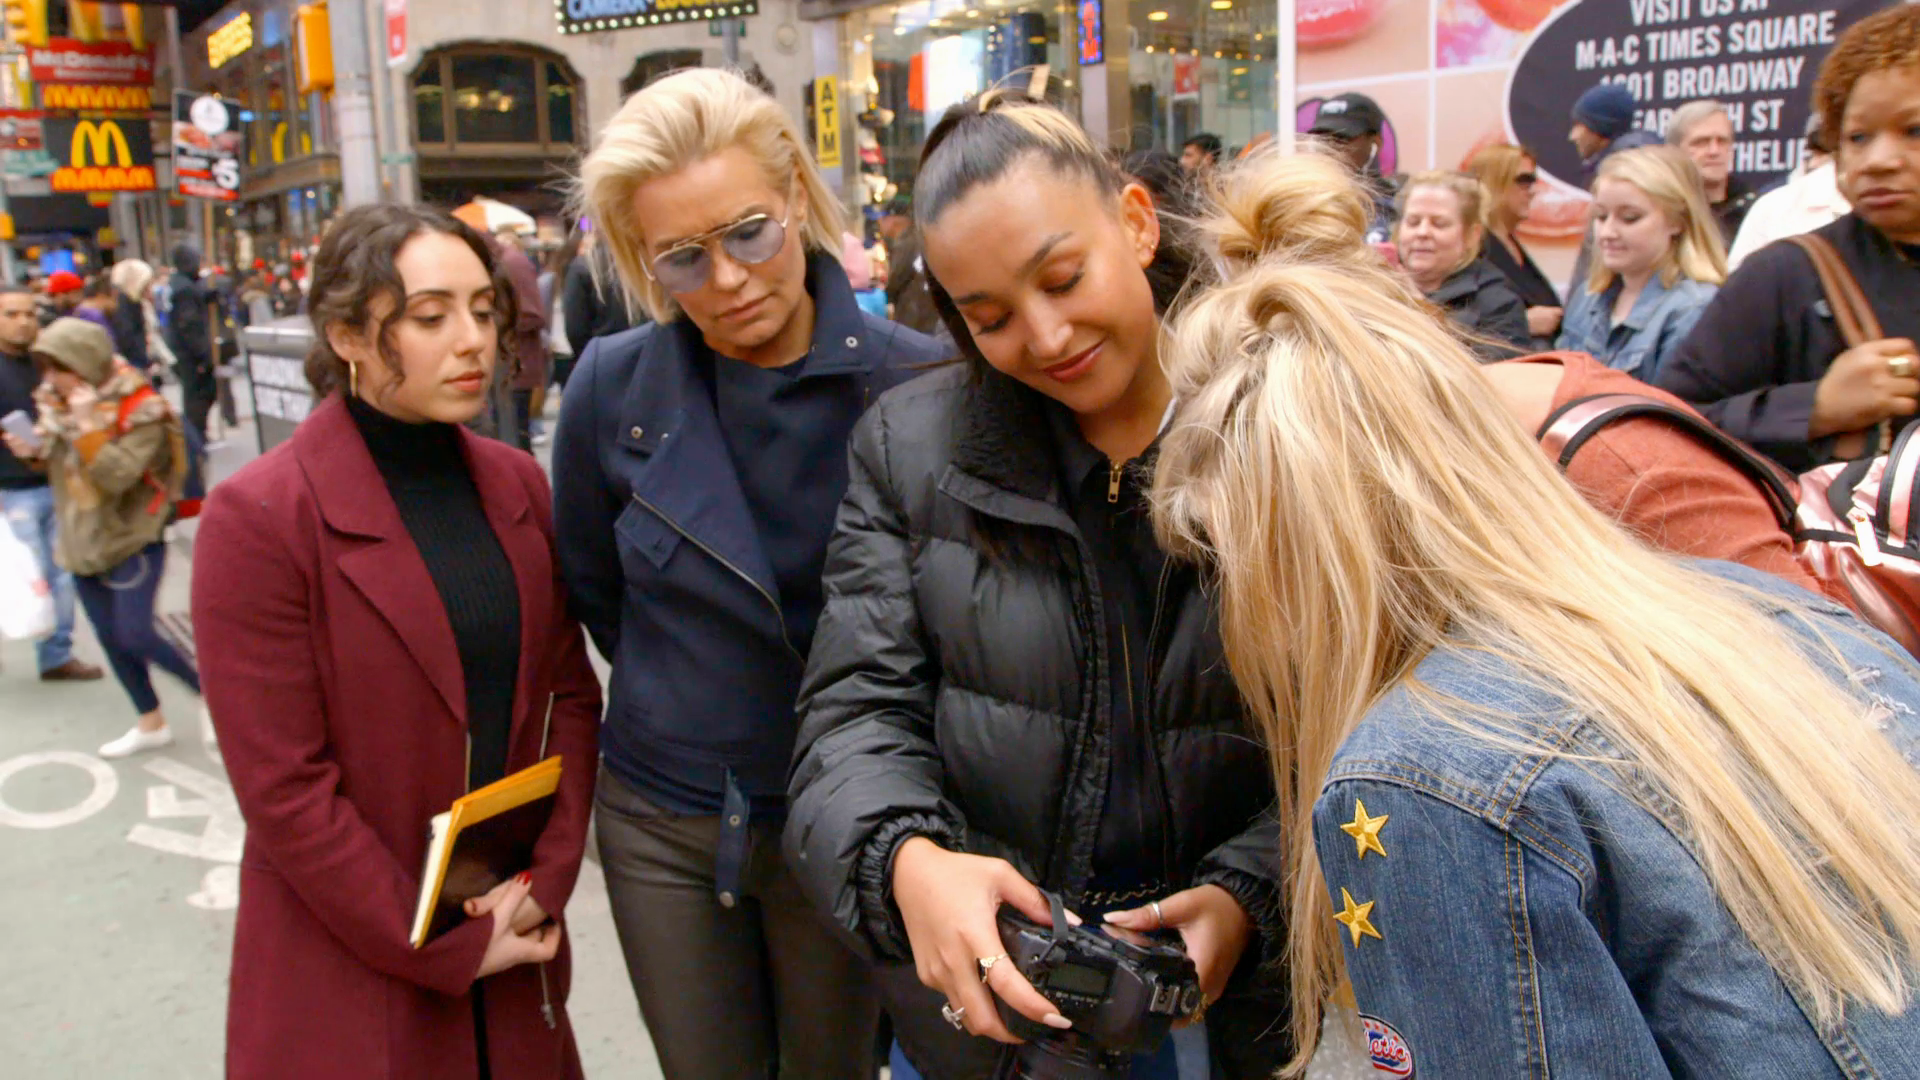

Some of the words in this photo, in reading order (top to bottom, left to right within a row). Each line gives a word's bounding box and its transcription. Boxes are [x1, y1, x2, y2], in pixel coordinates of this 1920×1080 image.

[1629, 0, 1691, 26] VISIT
[1699, 0, 1736, 18] US
[1645, 24, 1722, 62] TIMES
[1727, 10, 1837, 54] SQUARE
[1663, 55, 1806, 99] BROADWAY
[821, 81, 836, 152] ATM
[1751, 98, 1785, 133] ST
